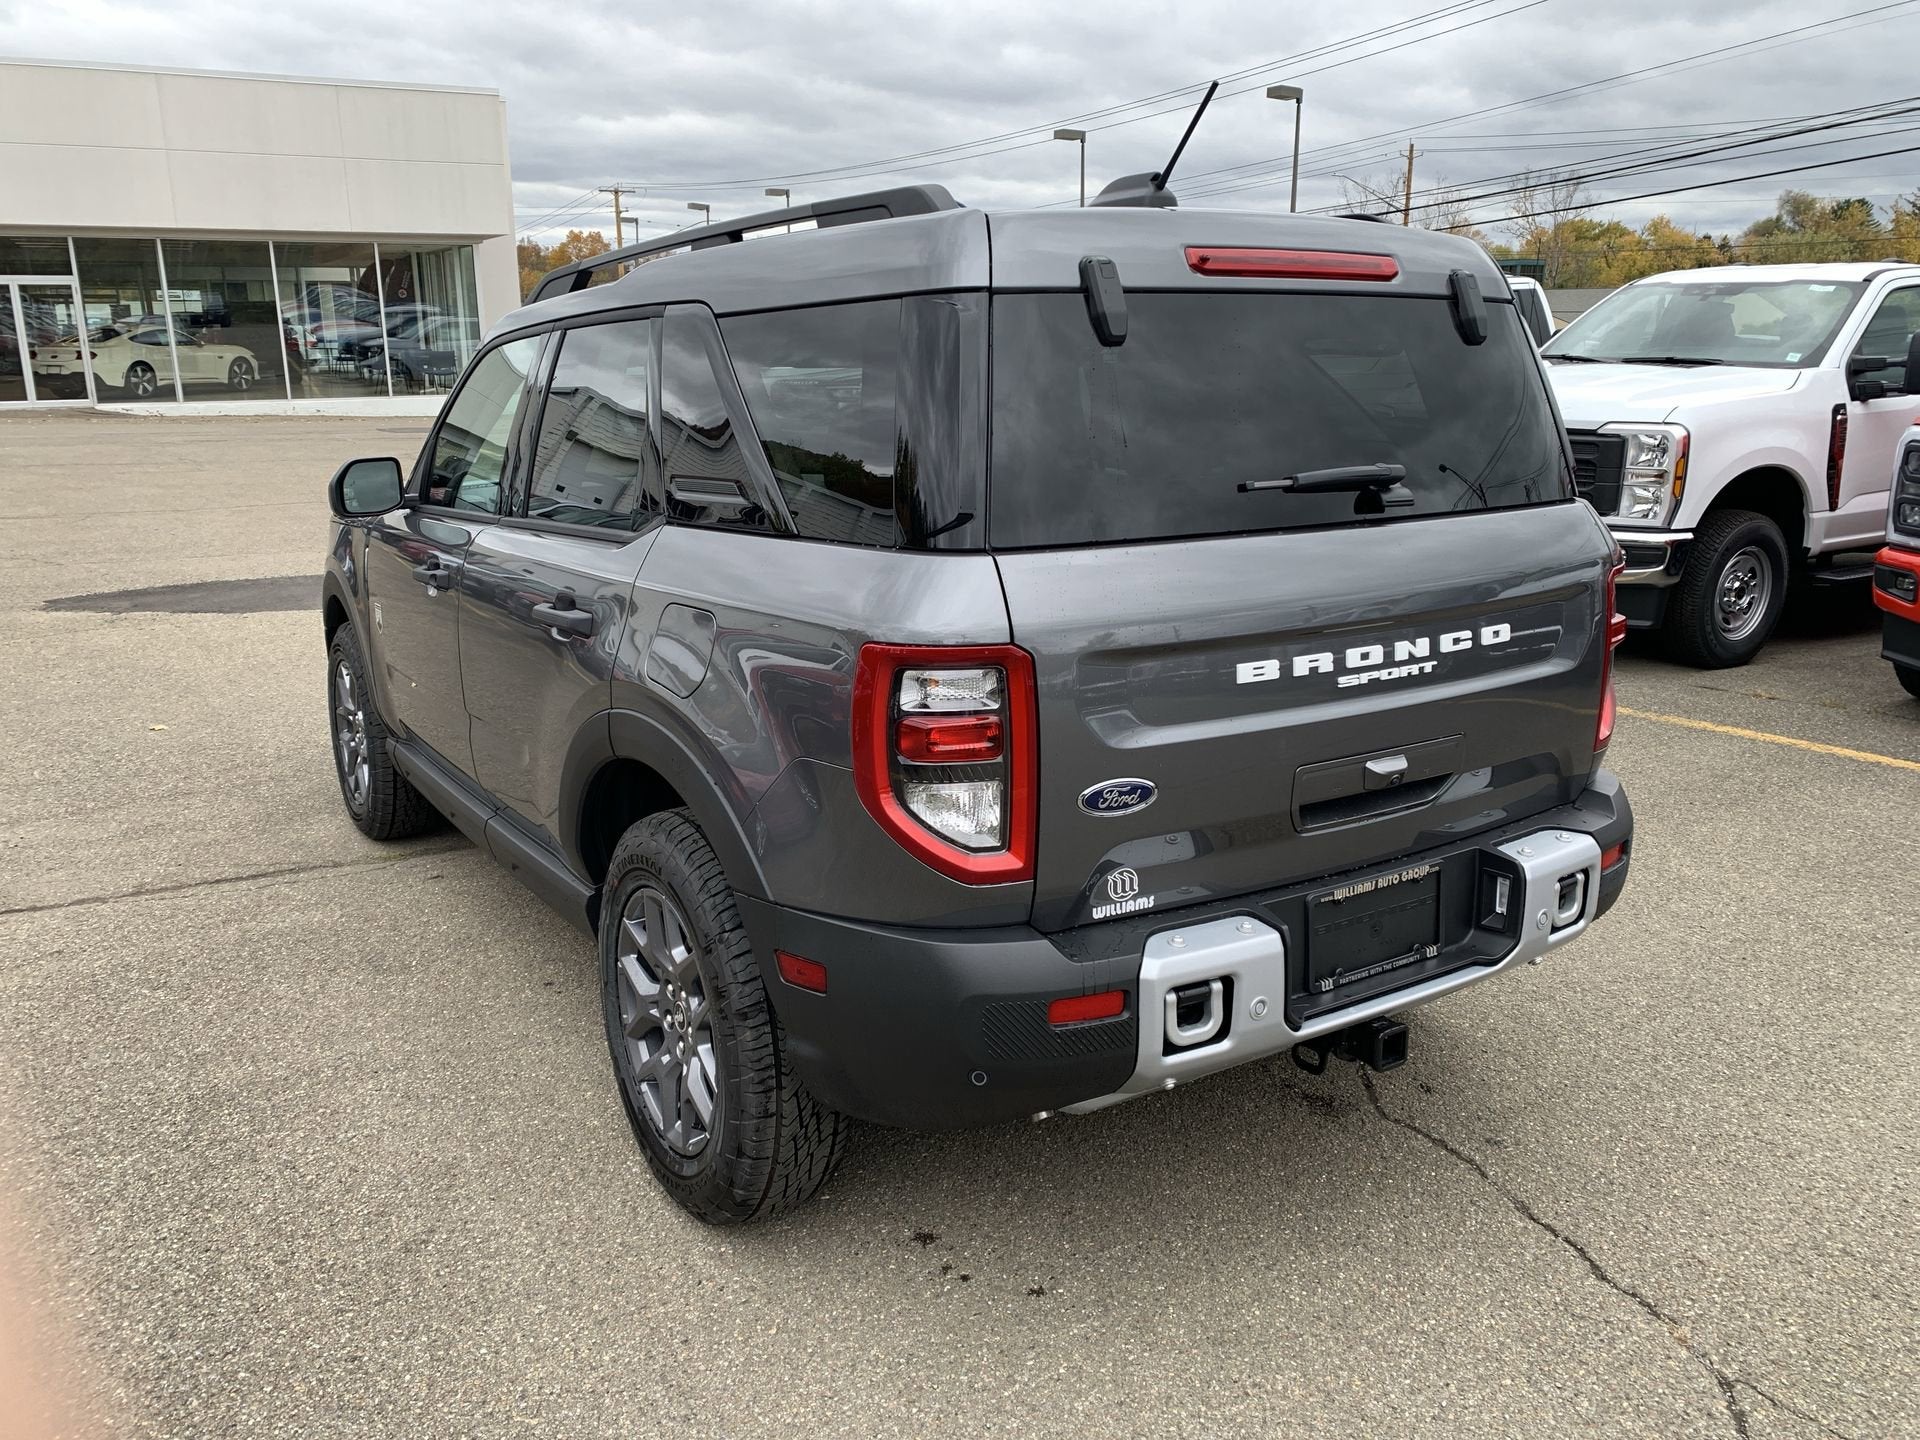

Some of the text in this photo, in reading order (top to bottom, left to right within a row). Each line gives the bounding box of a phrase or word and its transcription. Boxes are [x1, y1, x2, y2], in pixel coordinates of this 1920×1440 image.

[1236, 623, 1511, 684] BRONCO
[1337, 660, 1438, 688] SPORT
[1098, 785, 1142, 809] Ford
[1377, 874, 1400, 888] AUTO
[1092, 895, 1155, 919] WILLIAMS
[1339, 970, 1369, 985] PARTNERING
[1369, 966, 1383, 975] WITH
[1383, 963, 1393, 972] THE
[1392, 954, 1420, 969] COMMUNITY
